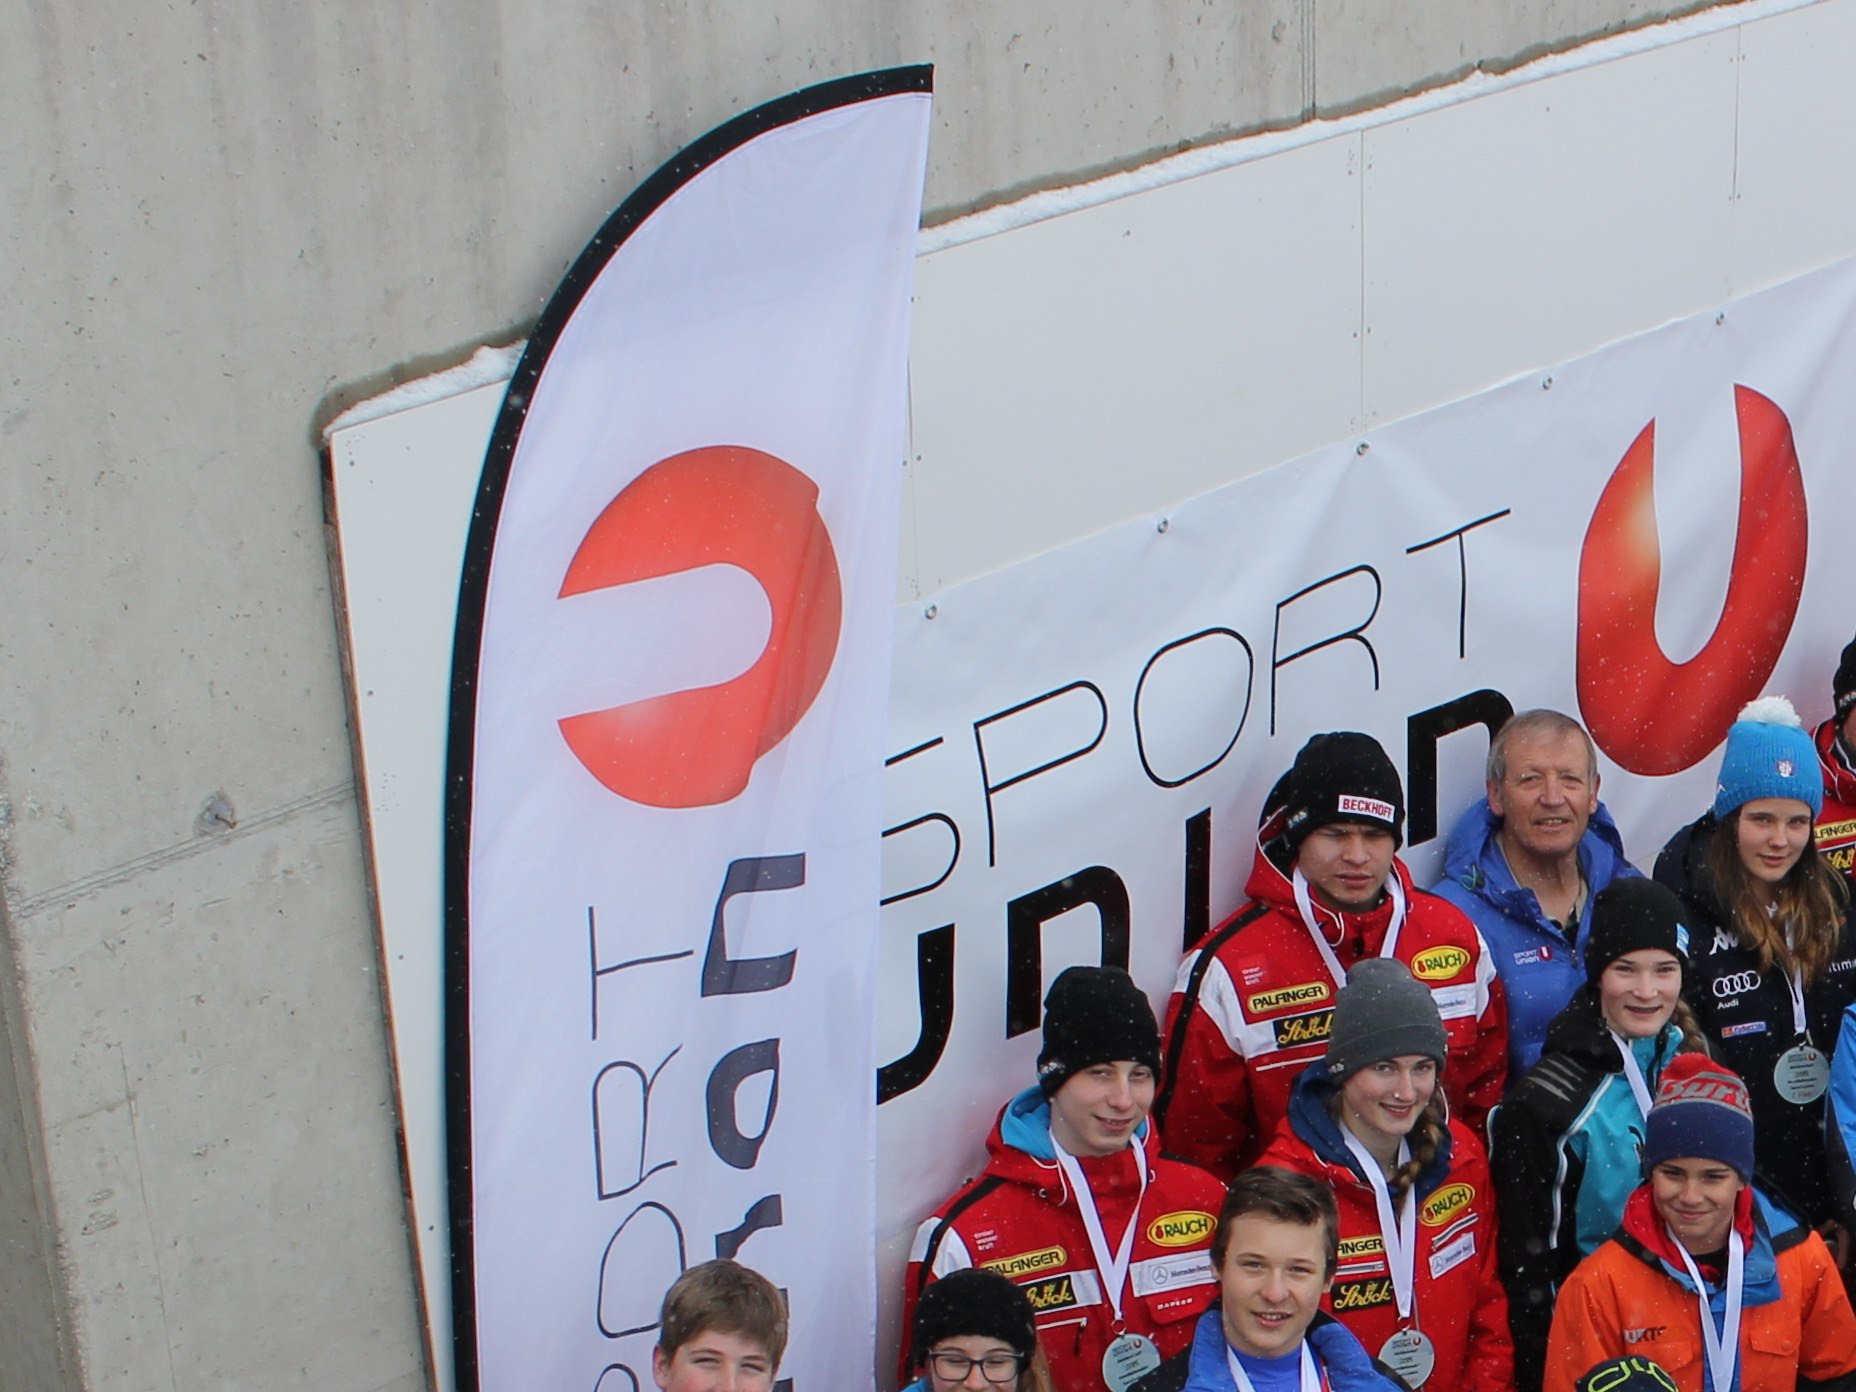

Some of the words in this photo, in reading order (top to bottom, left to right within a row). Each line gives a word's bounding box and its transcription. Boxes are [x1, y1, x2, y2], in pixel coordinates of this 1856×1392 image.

[1342, 798, 1393, 819] BECKHOFF
[1425, 951, 1462, 972] RAUCH
[1252, 985, 1325, 1008] PALFINGER
[1717, 999, 1740, 1010] Audi
[1431, 1188, 1468, 1218] RAUCH
[1163, 1218, 1209, 1240] RAUCH
[1334, 1282, 1392, 1312] Ströck
